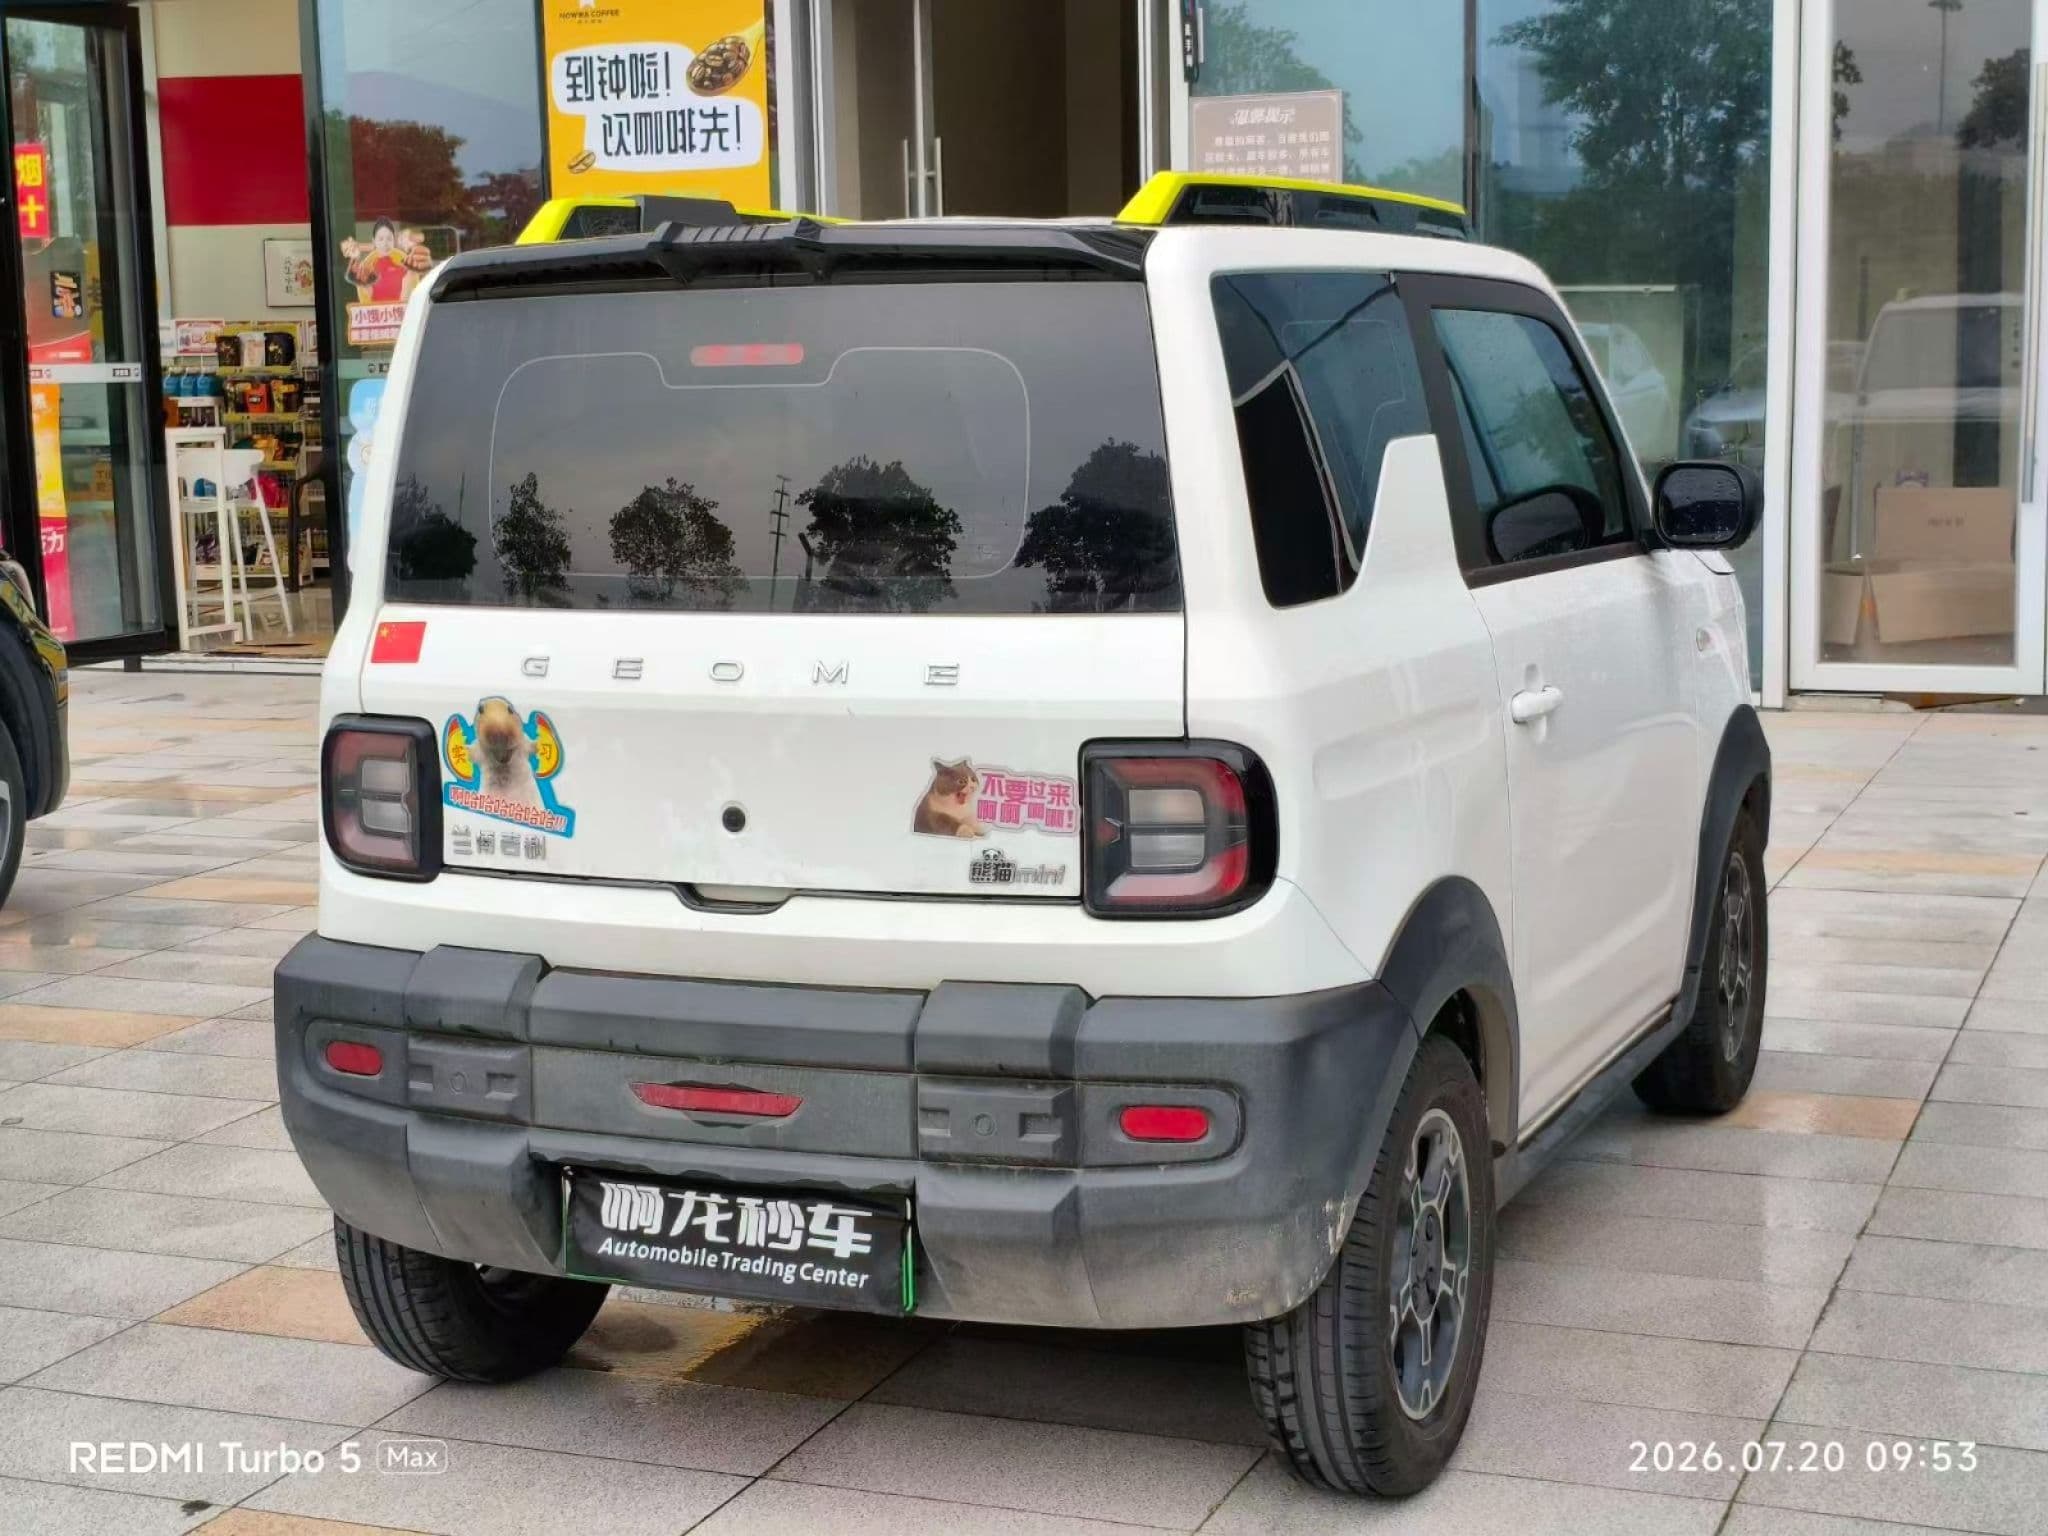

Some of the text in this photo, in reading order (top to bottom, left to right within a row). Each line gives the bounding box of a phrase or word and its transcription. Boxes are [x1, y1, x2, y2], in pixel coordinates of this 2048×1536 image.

[565, 51, 670, 102] 到钟啦！
[521, 656, 960, 686] GEOME
[981, 773, 1071, 806] 不要过来
[598, 1236, 869, 1289] Automobile Trading Center
